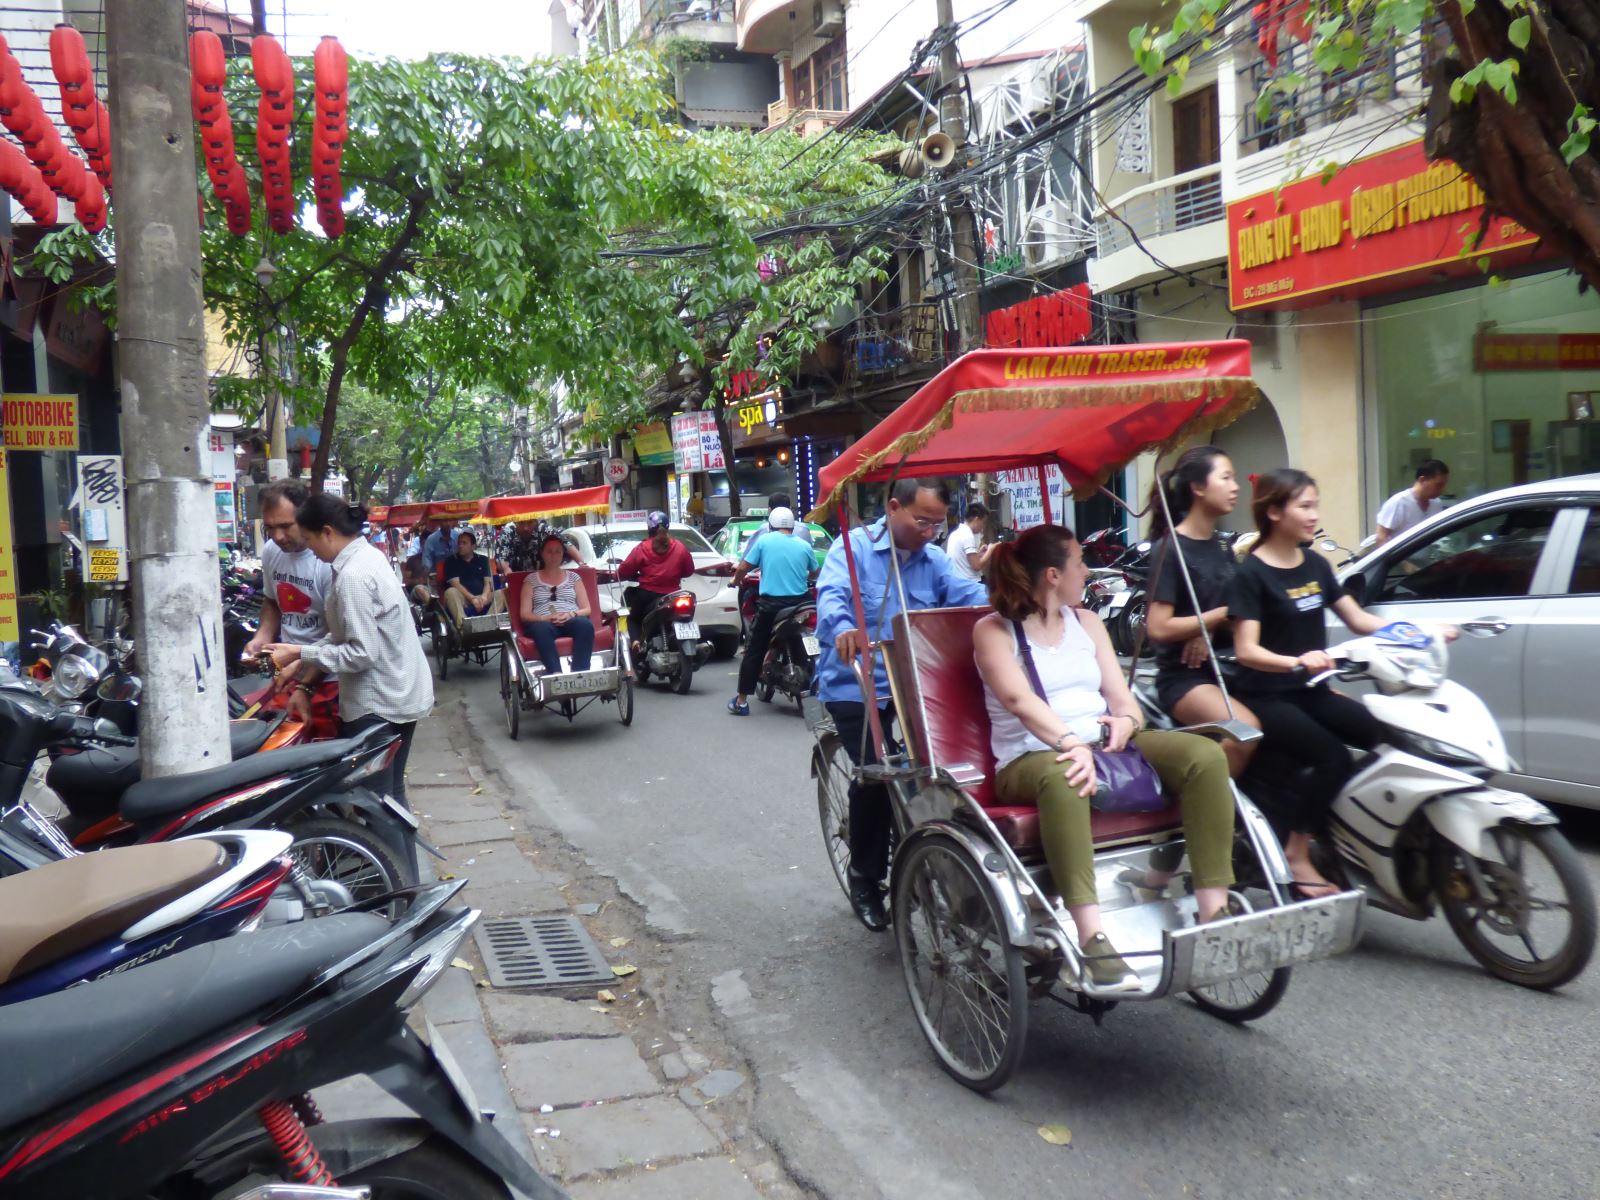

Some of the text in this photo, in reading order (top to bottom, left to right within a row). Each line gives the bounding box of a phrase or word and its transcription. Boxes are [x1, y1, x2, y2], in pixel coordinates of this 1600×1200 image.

[1050, 354, 1093, 377] ANH
[739, 402, 764, 436] spa
[4, 430, 74, 447] ELL, BUY & FIX
[190, 1026, 308, 1105] BLADE
